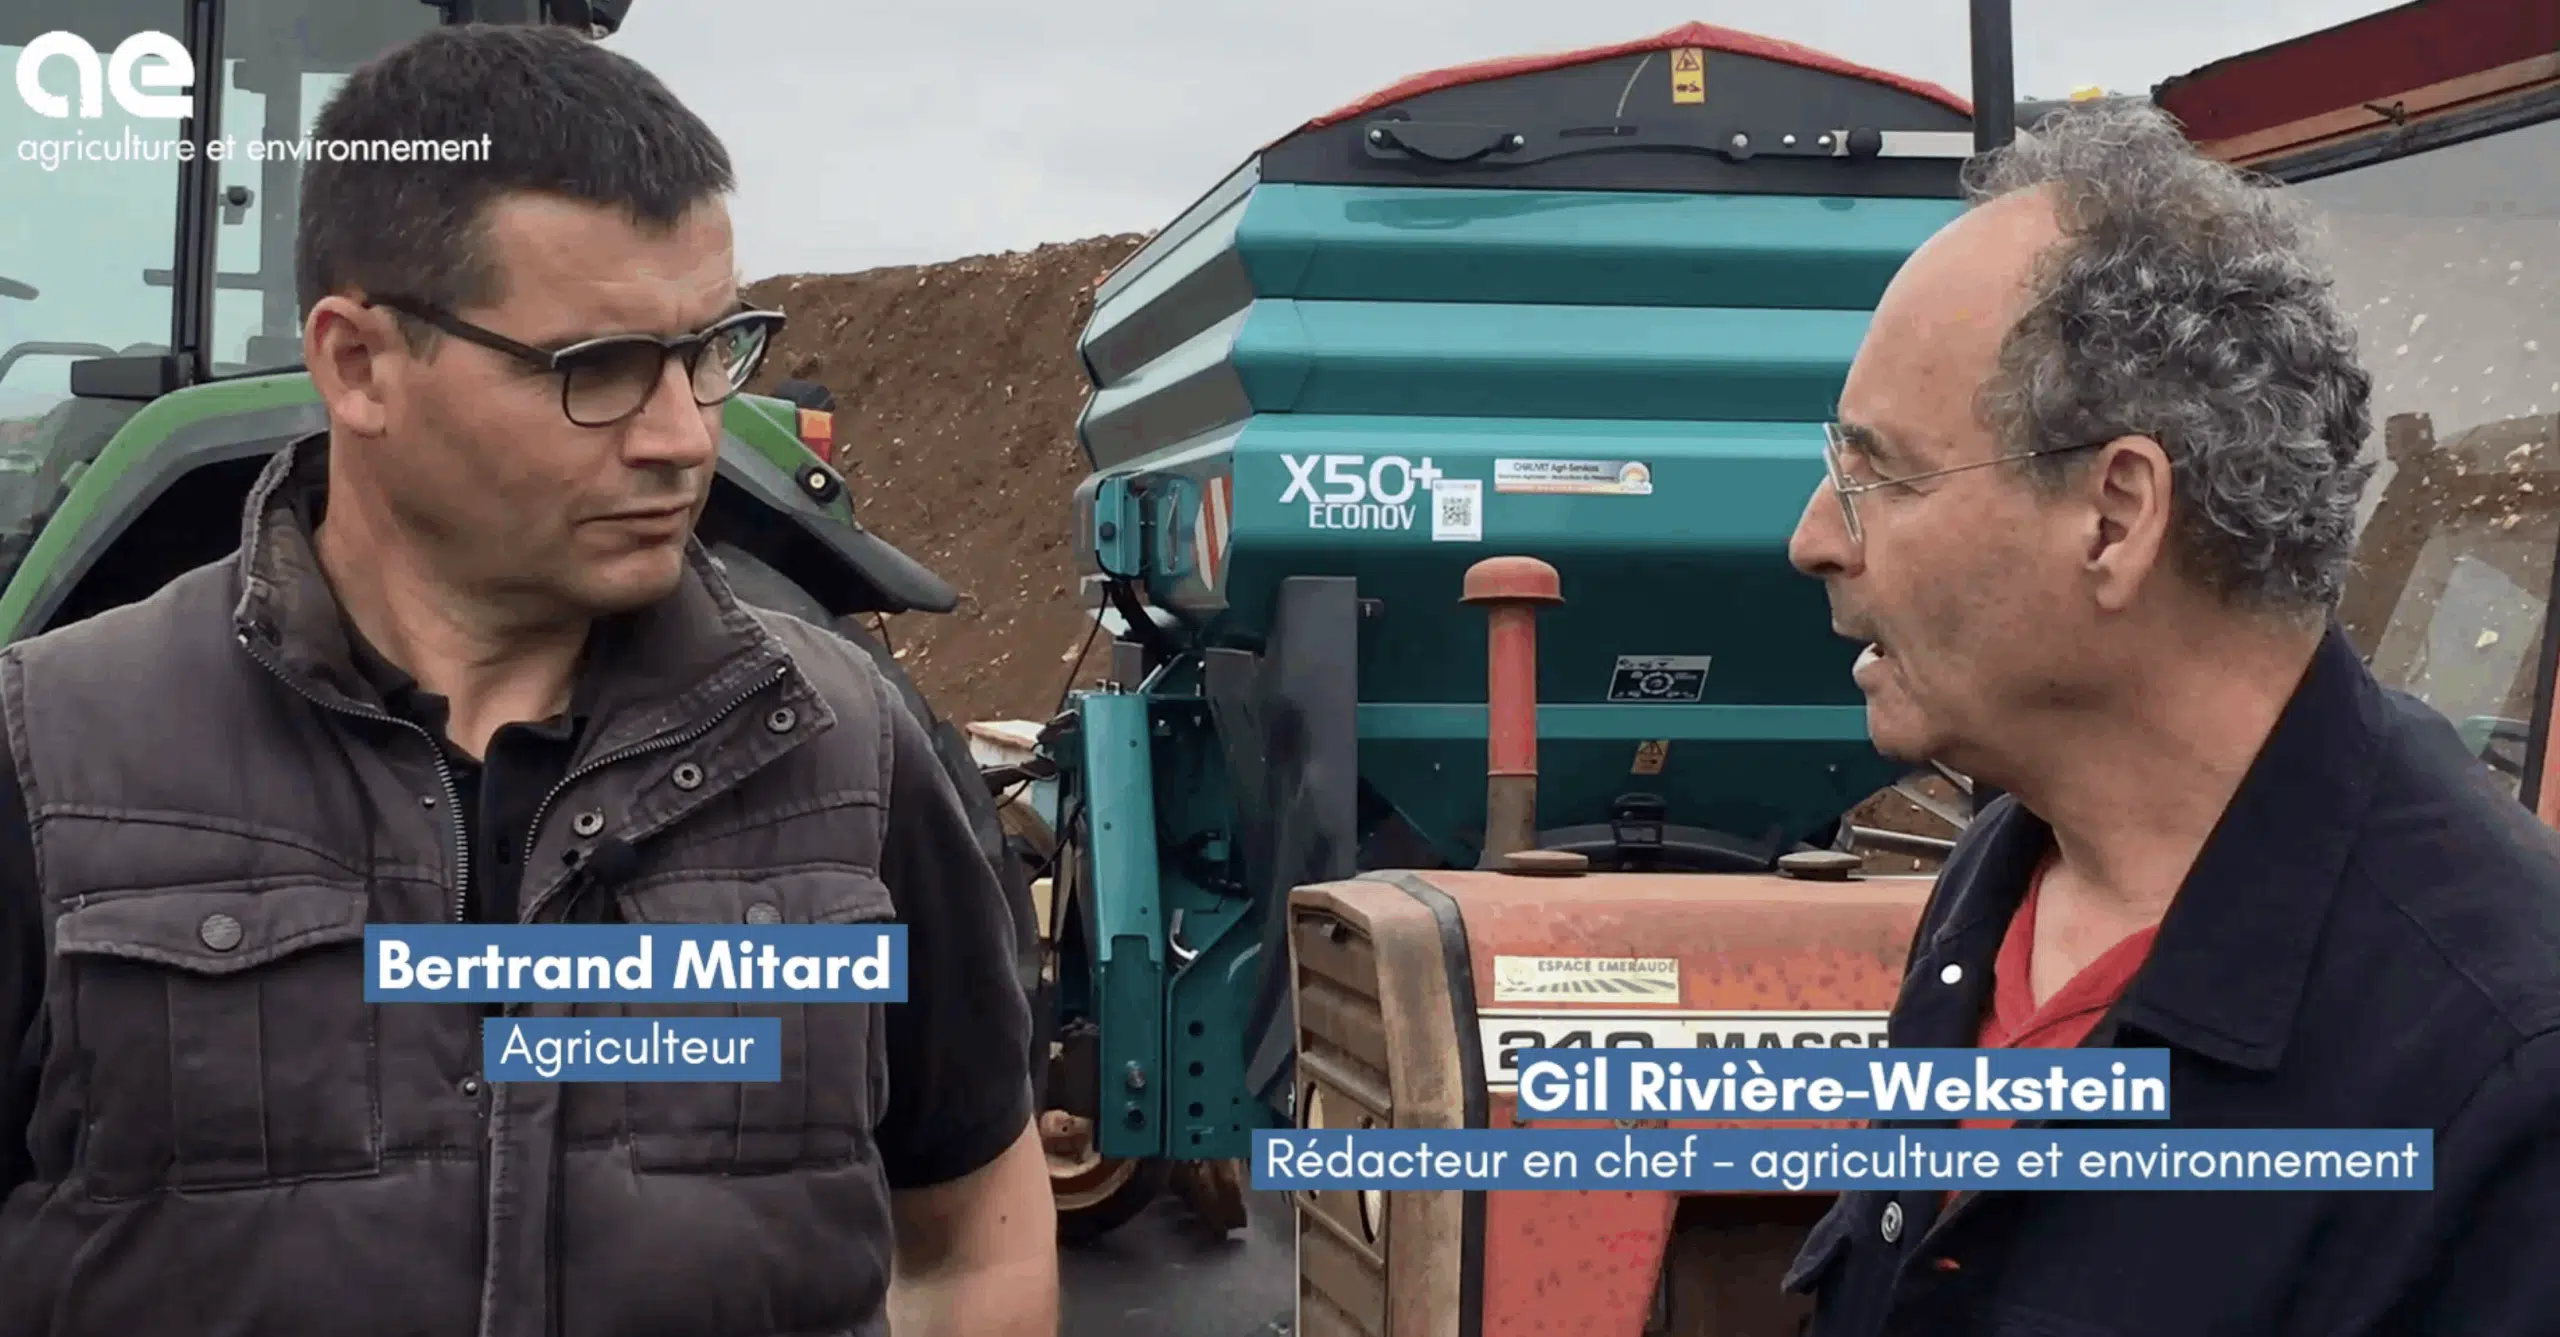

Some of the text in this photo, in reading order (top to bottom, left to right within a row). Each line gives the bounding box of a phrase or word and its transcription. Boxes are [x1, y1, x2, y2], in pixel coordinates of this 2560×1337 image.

[1278, 453, 1444, 505] X50+
[1537, 959, 1676, 974] ESPACE EMERAUDE
